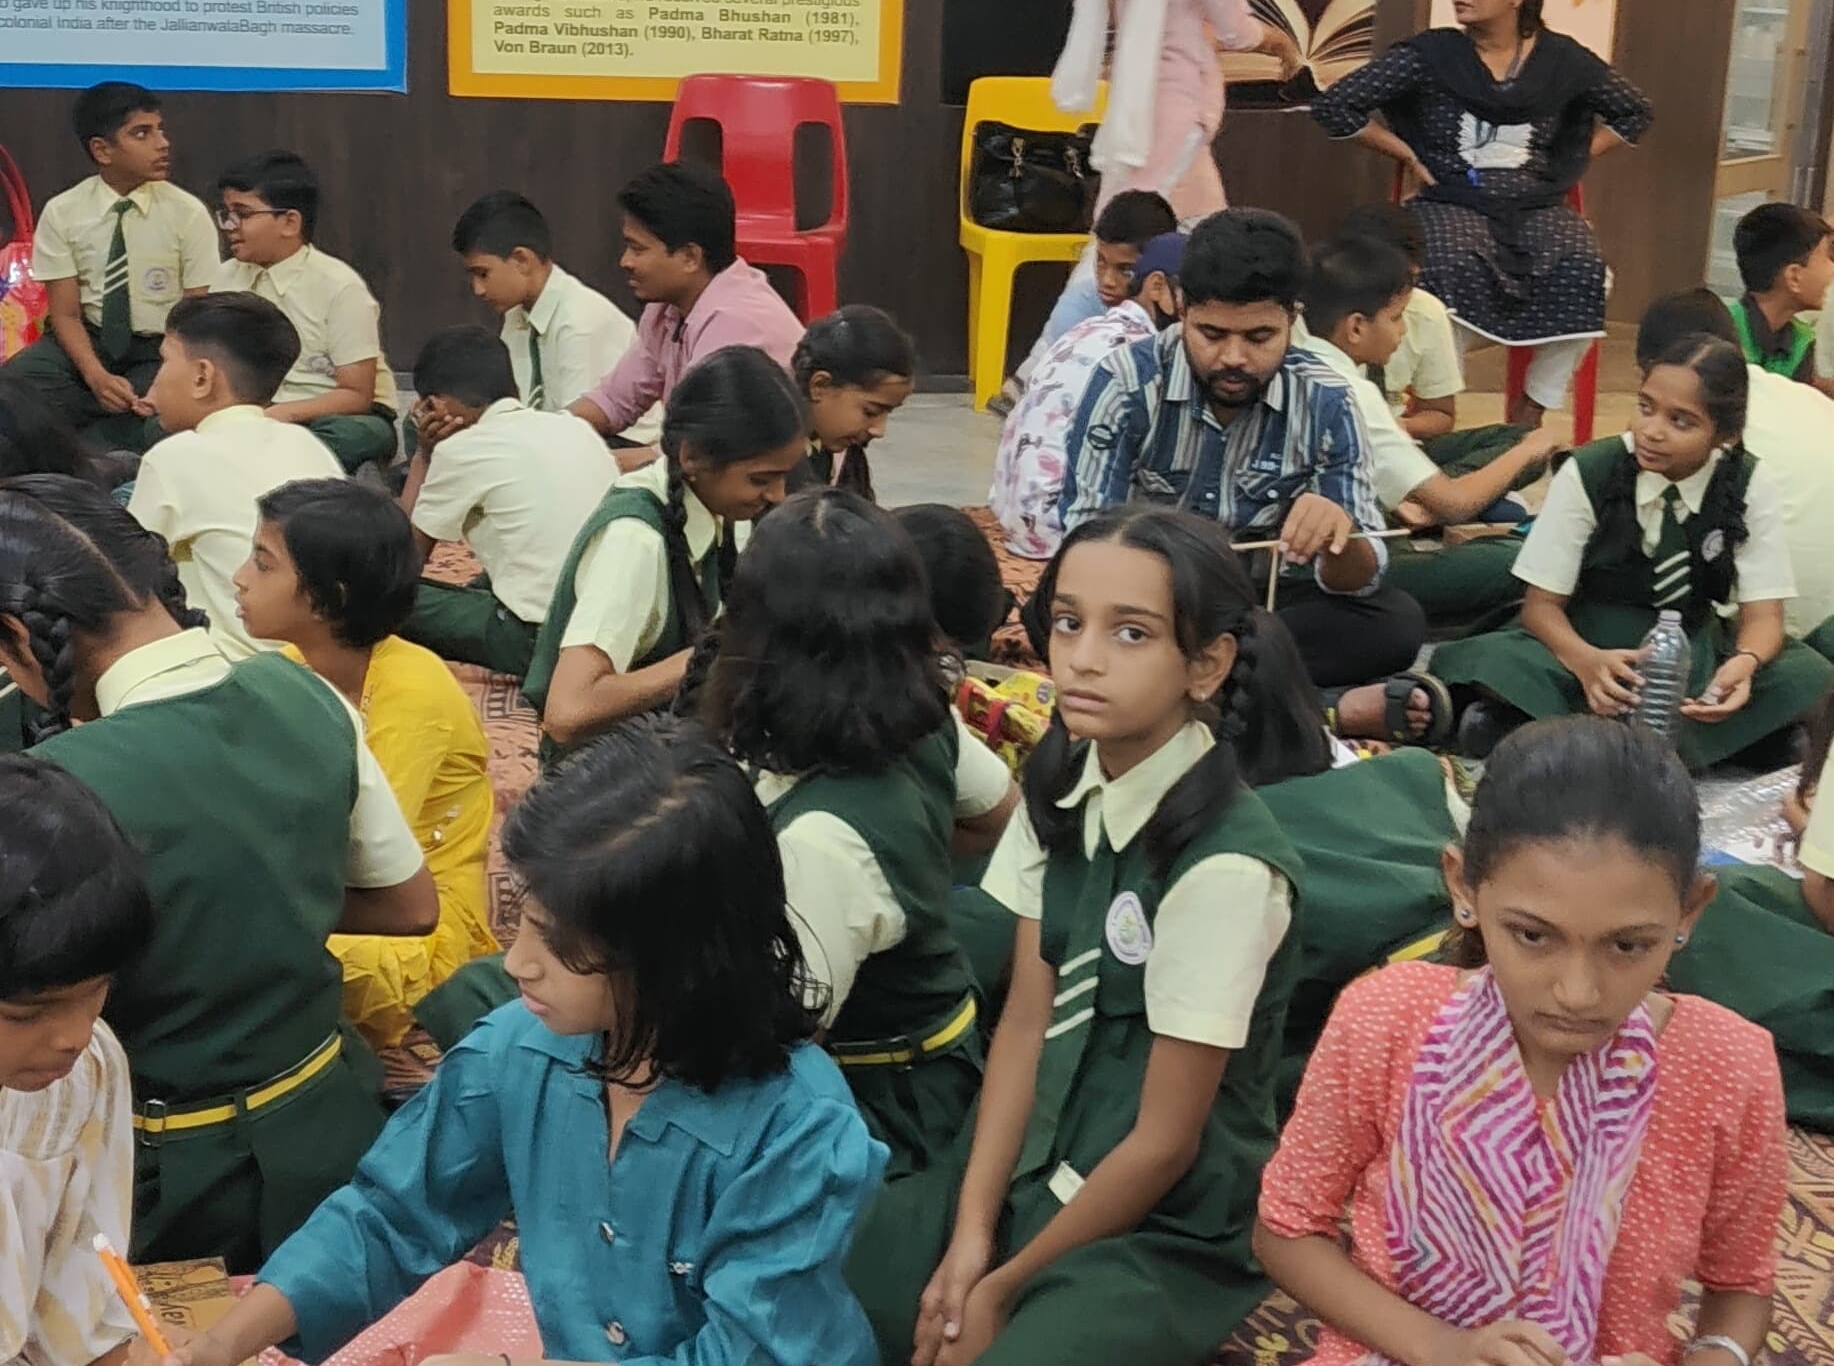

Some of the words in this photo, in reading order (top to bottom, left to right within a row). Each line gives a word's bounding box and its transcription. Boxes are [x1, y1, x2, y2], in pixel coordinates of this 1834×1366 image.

[256, 0, 302, 14] British
[305, 0, 359, 18] policies
[493, 3, 551, 18] awards
[564, 4, 601, 19] such
[648, 7, 705, 22] Padma
[718, 9, 792, 24] Bhushan
[57, 15, 93, 30] India
[95, 15, 130, 30] after
[281, 22, 354, 34] massacre.
[493, 21, 550, 36] Padma
[553, 22, 639, 38] Vibhushan
[701, 26, 753, 41] Bharat
[757, 27, 804, 42] Ratna
[493, 38, 525, 53] Von
[528, 39, 578, 54] Braun
[581, 41, 635, 58] (2013).
